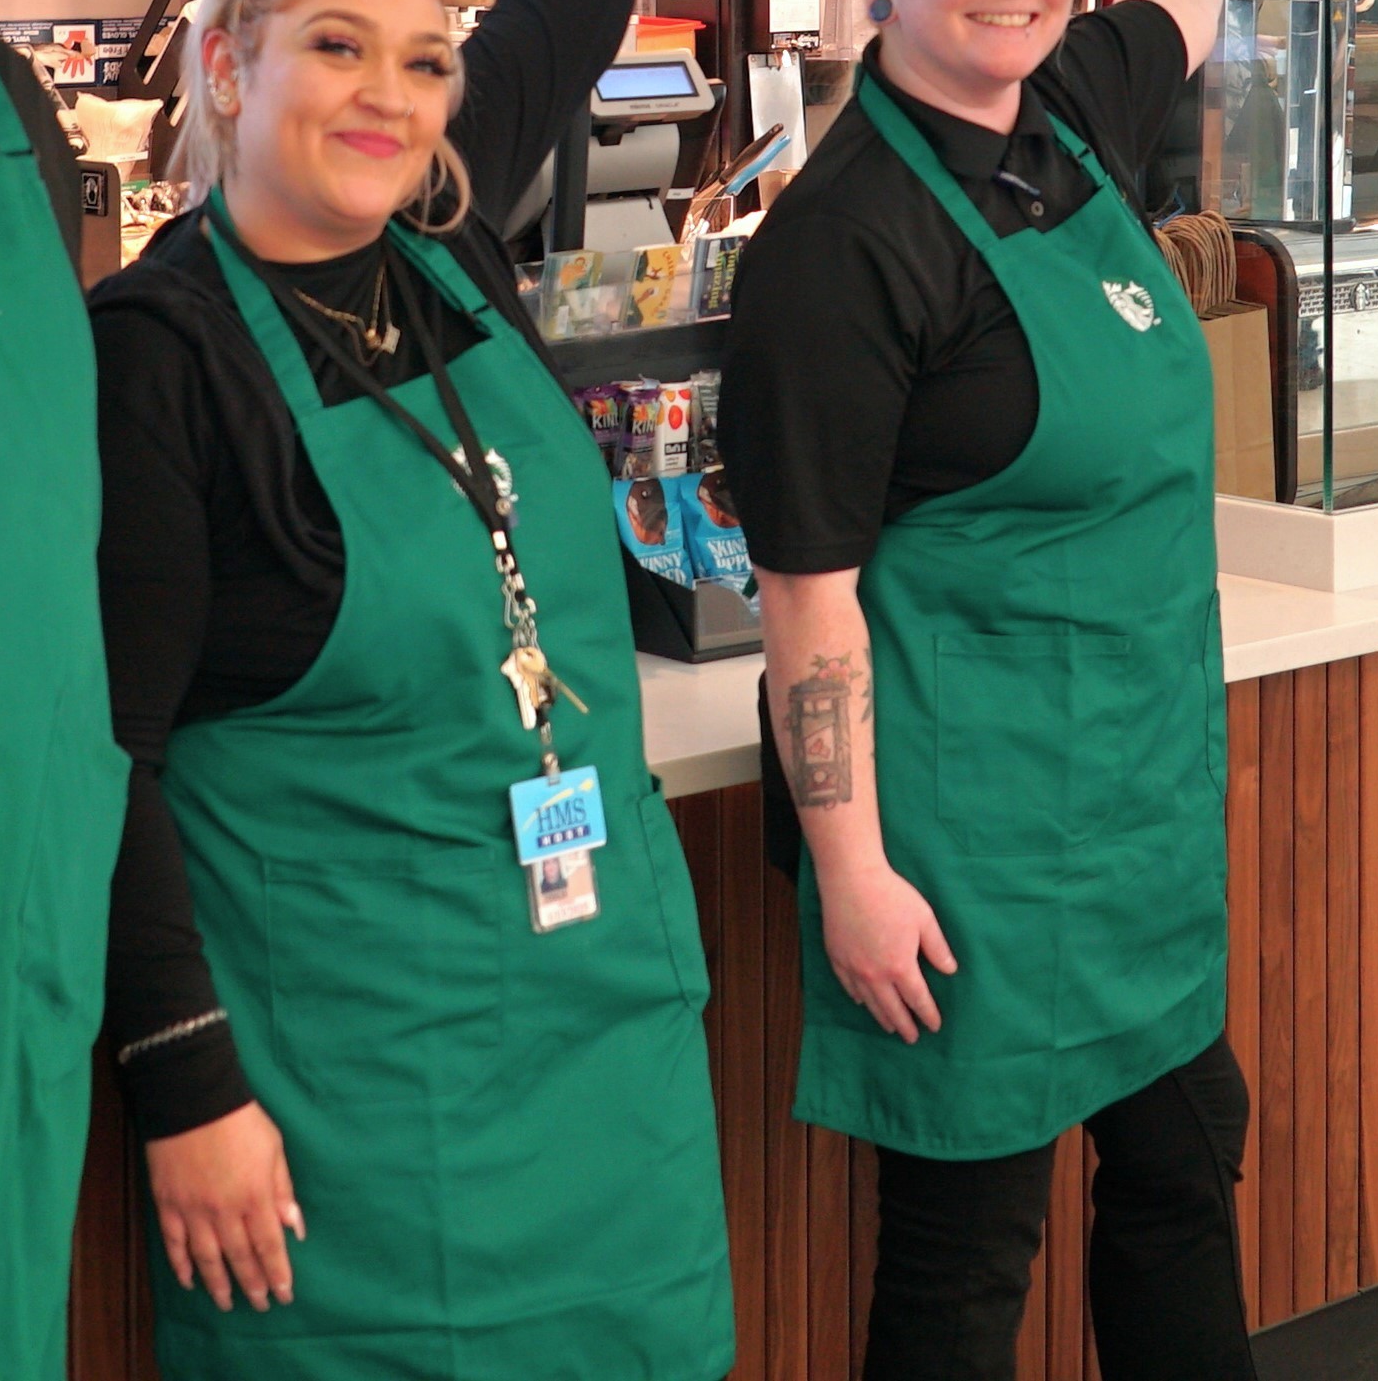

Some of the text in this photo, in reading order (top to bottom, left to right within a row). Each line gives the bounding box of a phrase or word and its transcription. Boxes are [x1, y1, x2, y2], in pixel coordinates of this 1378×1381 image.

[632, 420, 657, 435] KIN
[707, 536, 748, 557] SKIN
[536, 796, 587, 833] HMS
[541, 826, 585, 846] HOST
